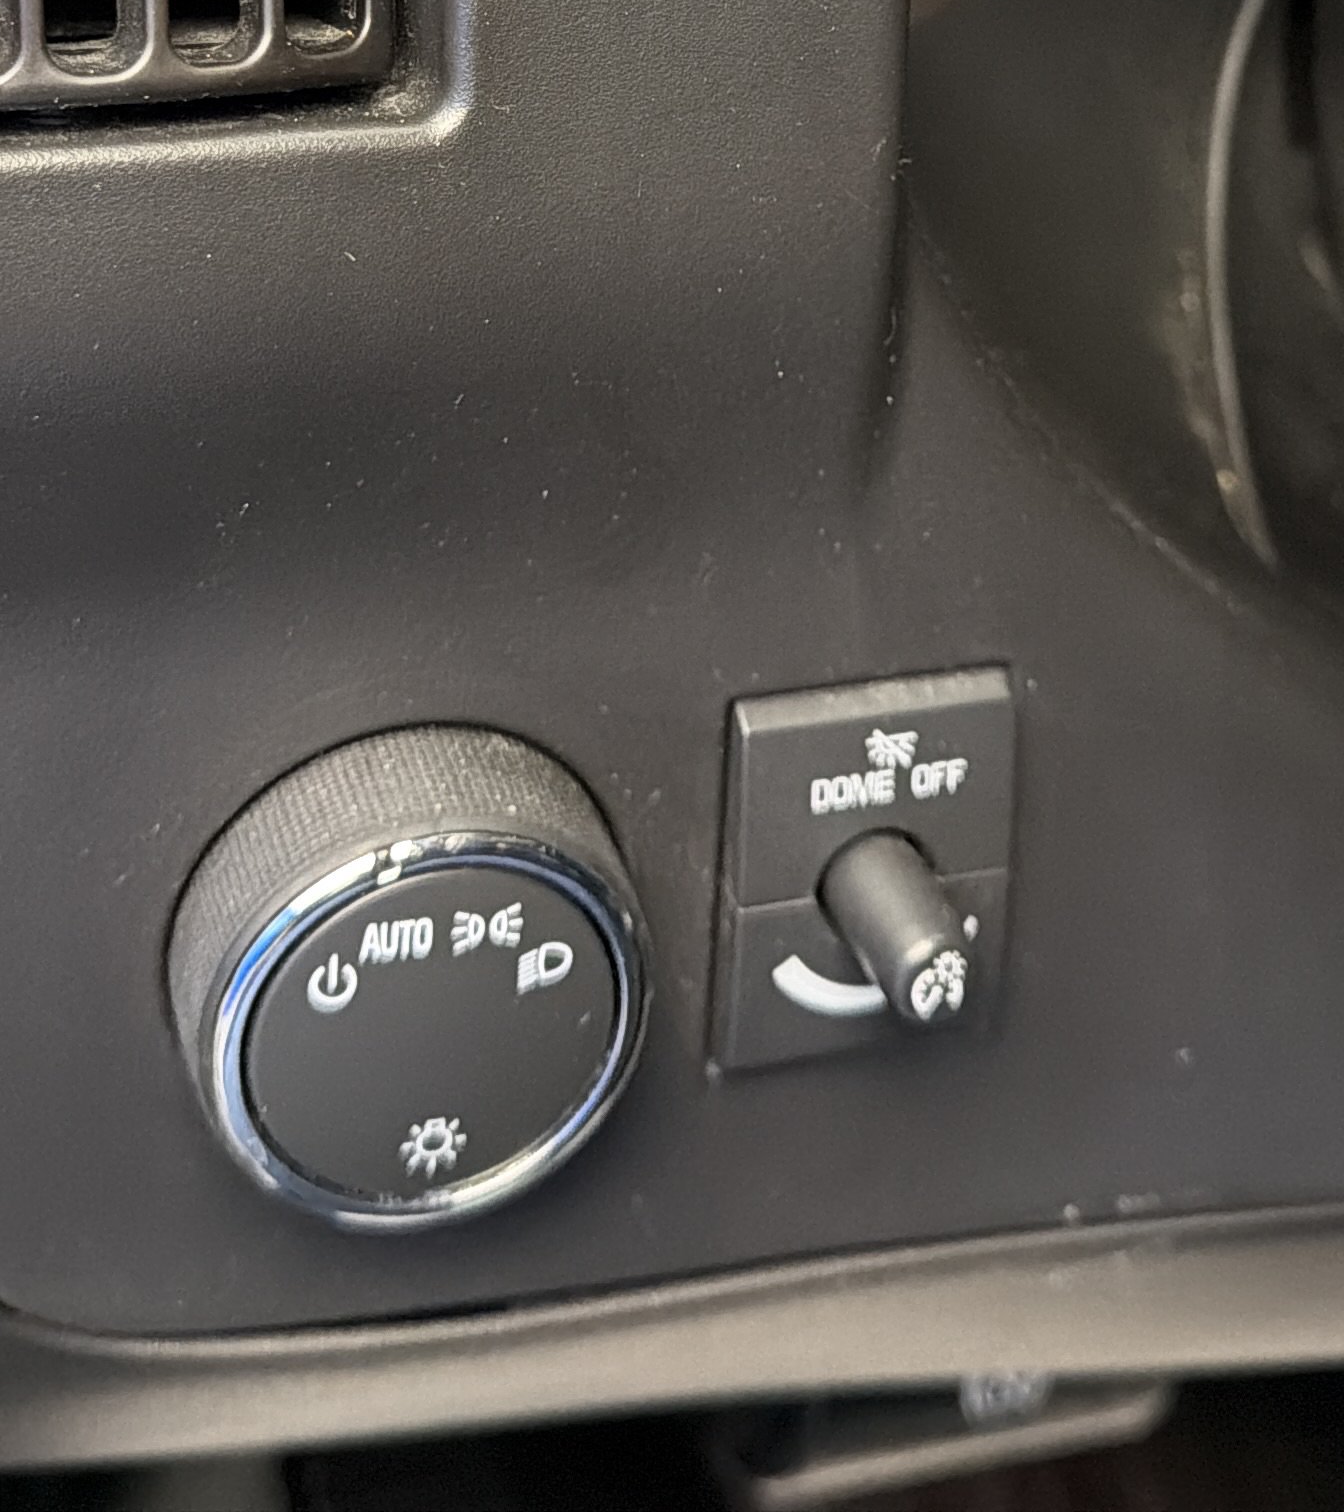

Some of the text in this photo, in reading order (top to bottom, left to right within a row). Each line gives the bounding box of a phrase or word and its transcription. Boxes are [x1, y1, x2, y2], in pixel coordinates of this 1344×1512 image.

[810, 757, 968, 816] DOME OFF
[359, 916, 434, 966] AUTO
